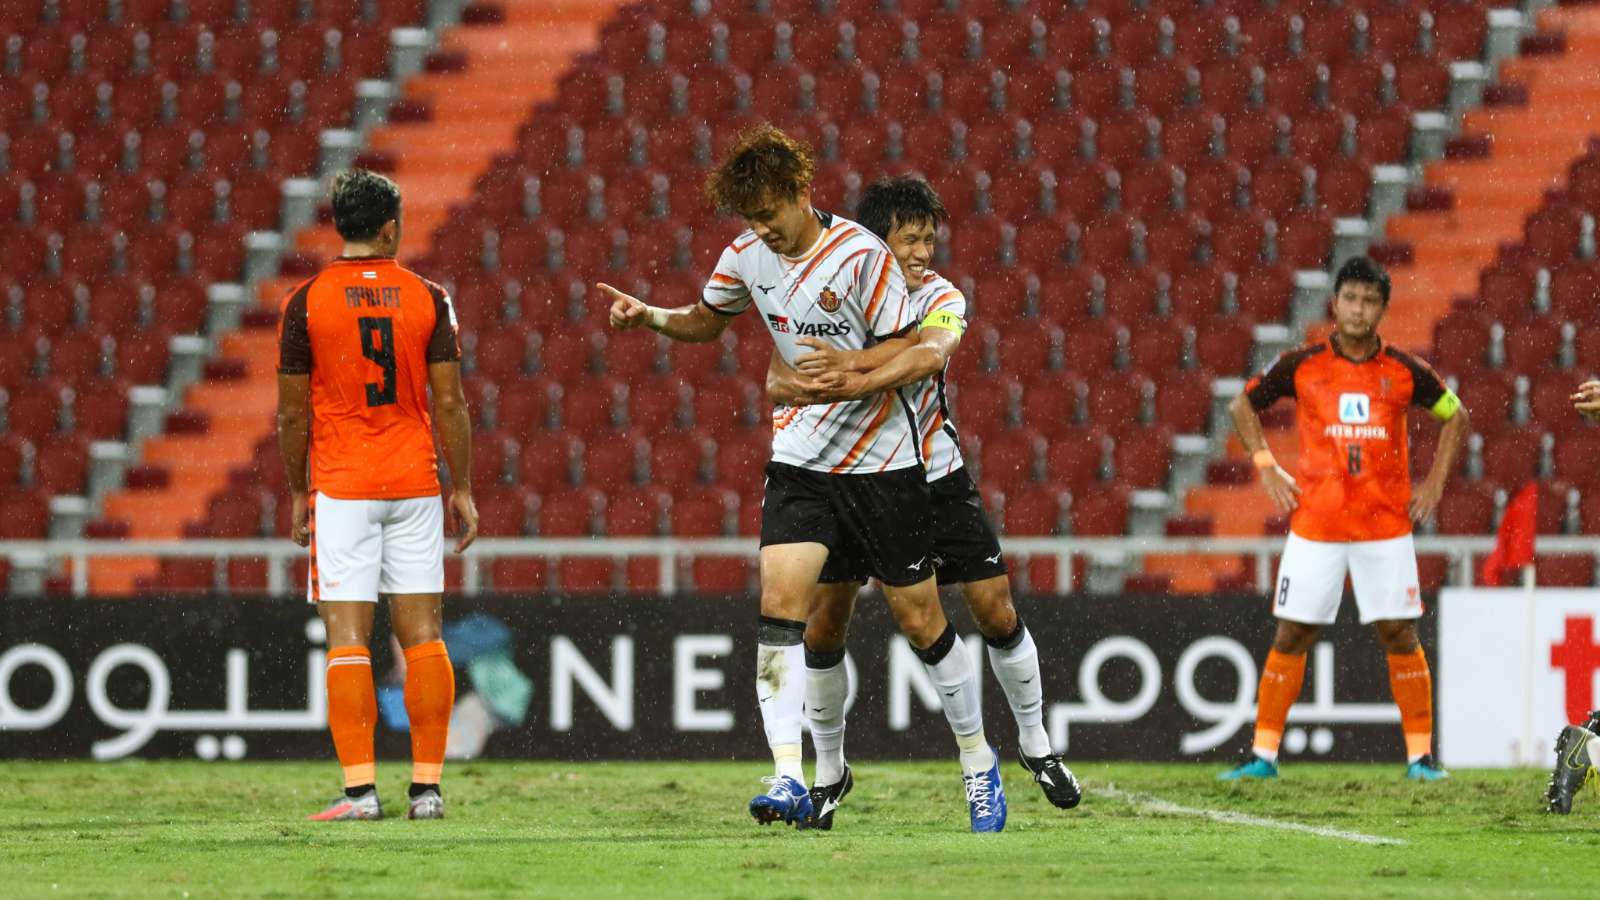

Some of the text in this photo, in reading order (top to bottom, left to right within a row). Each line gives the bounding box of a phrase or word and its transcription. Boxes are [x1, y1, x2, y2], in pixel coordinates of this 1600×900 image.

[793, 319, 851, 337] YARIS
[358, 317, 396, 407] 9
[1278, 577, 1290, 606] 8
[1049, 636, 1401, 754] يوم
